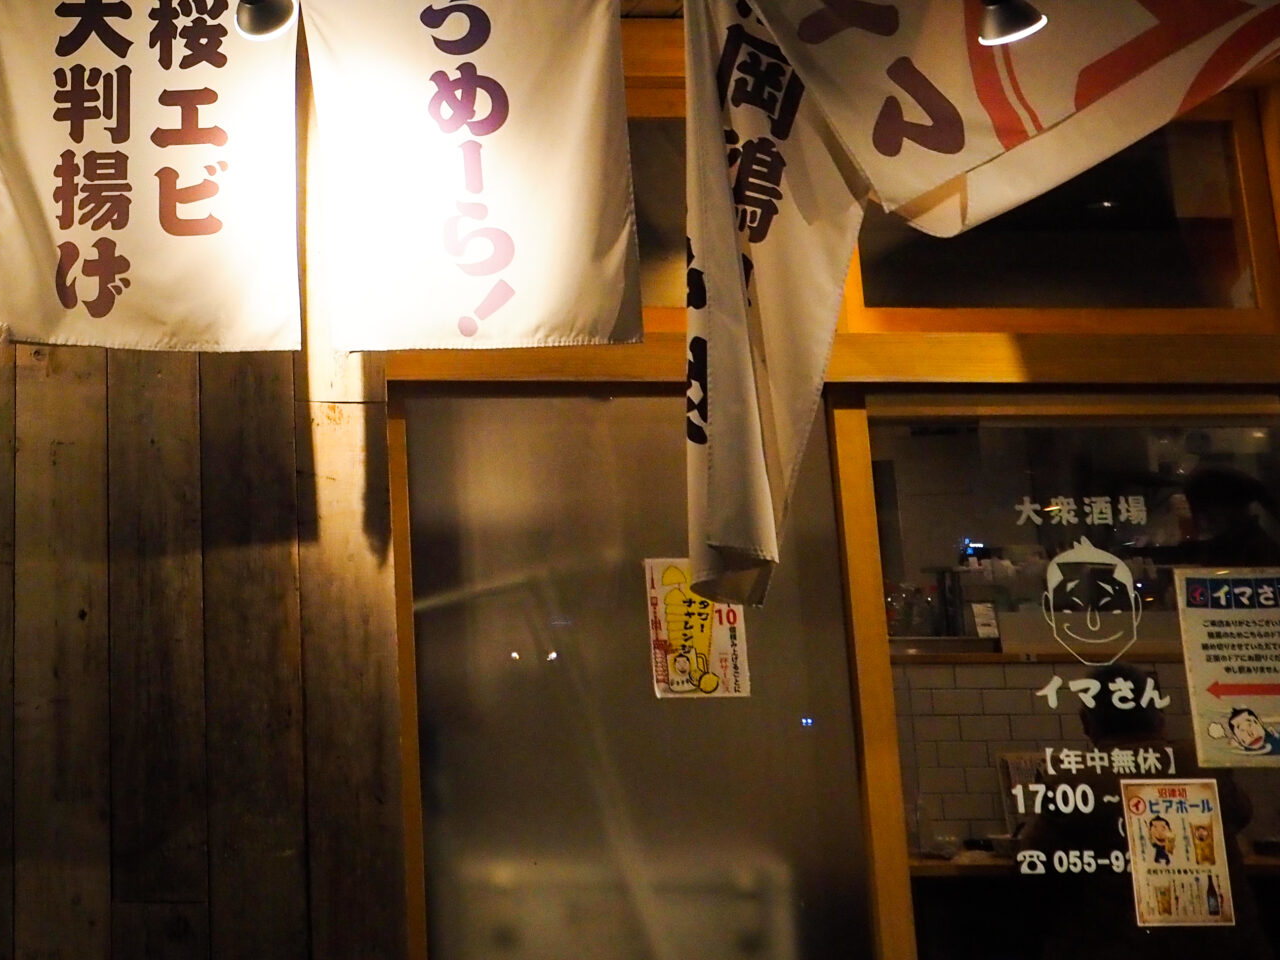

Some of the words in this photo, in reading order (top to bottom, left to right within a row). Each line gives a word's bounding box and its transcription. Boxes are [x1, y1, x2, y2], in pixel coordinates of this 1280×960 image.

[1014, 494, 1148, 526] 大衆酒場
[1211, 584, 1280, 607] イマさ
[715, 608, 738, 627] 10
[1035, 675, 1171, 709] イマさん
